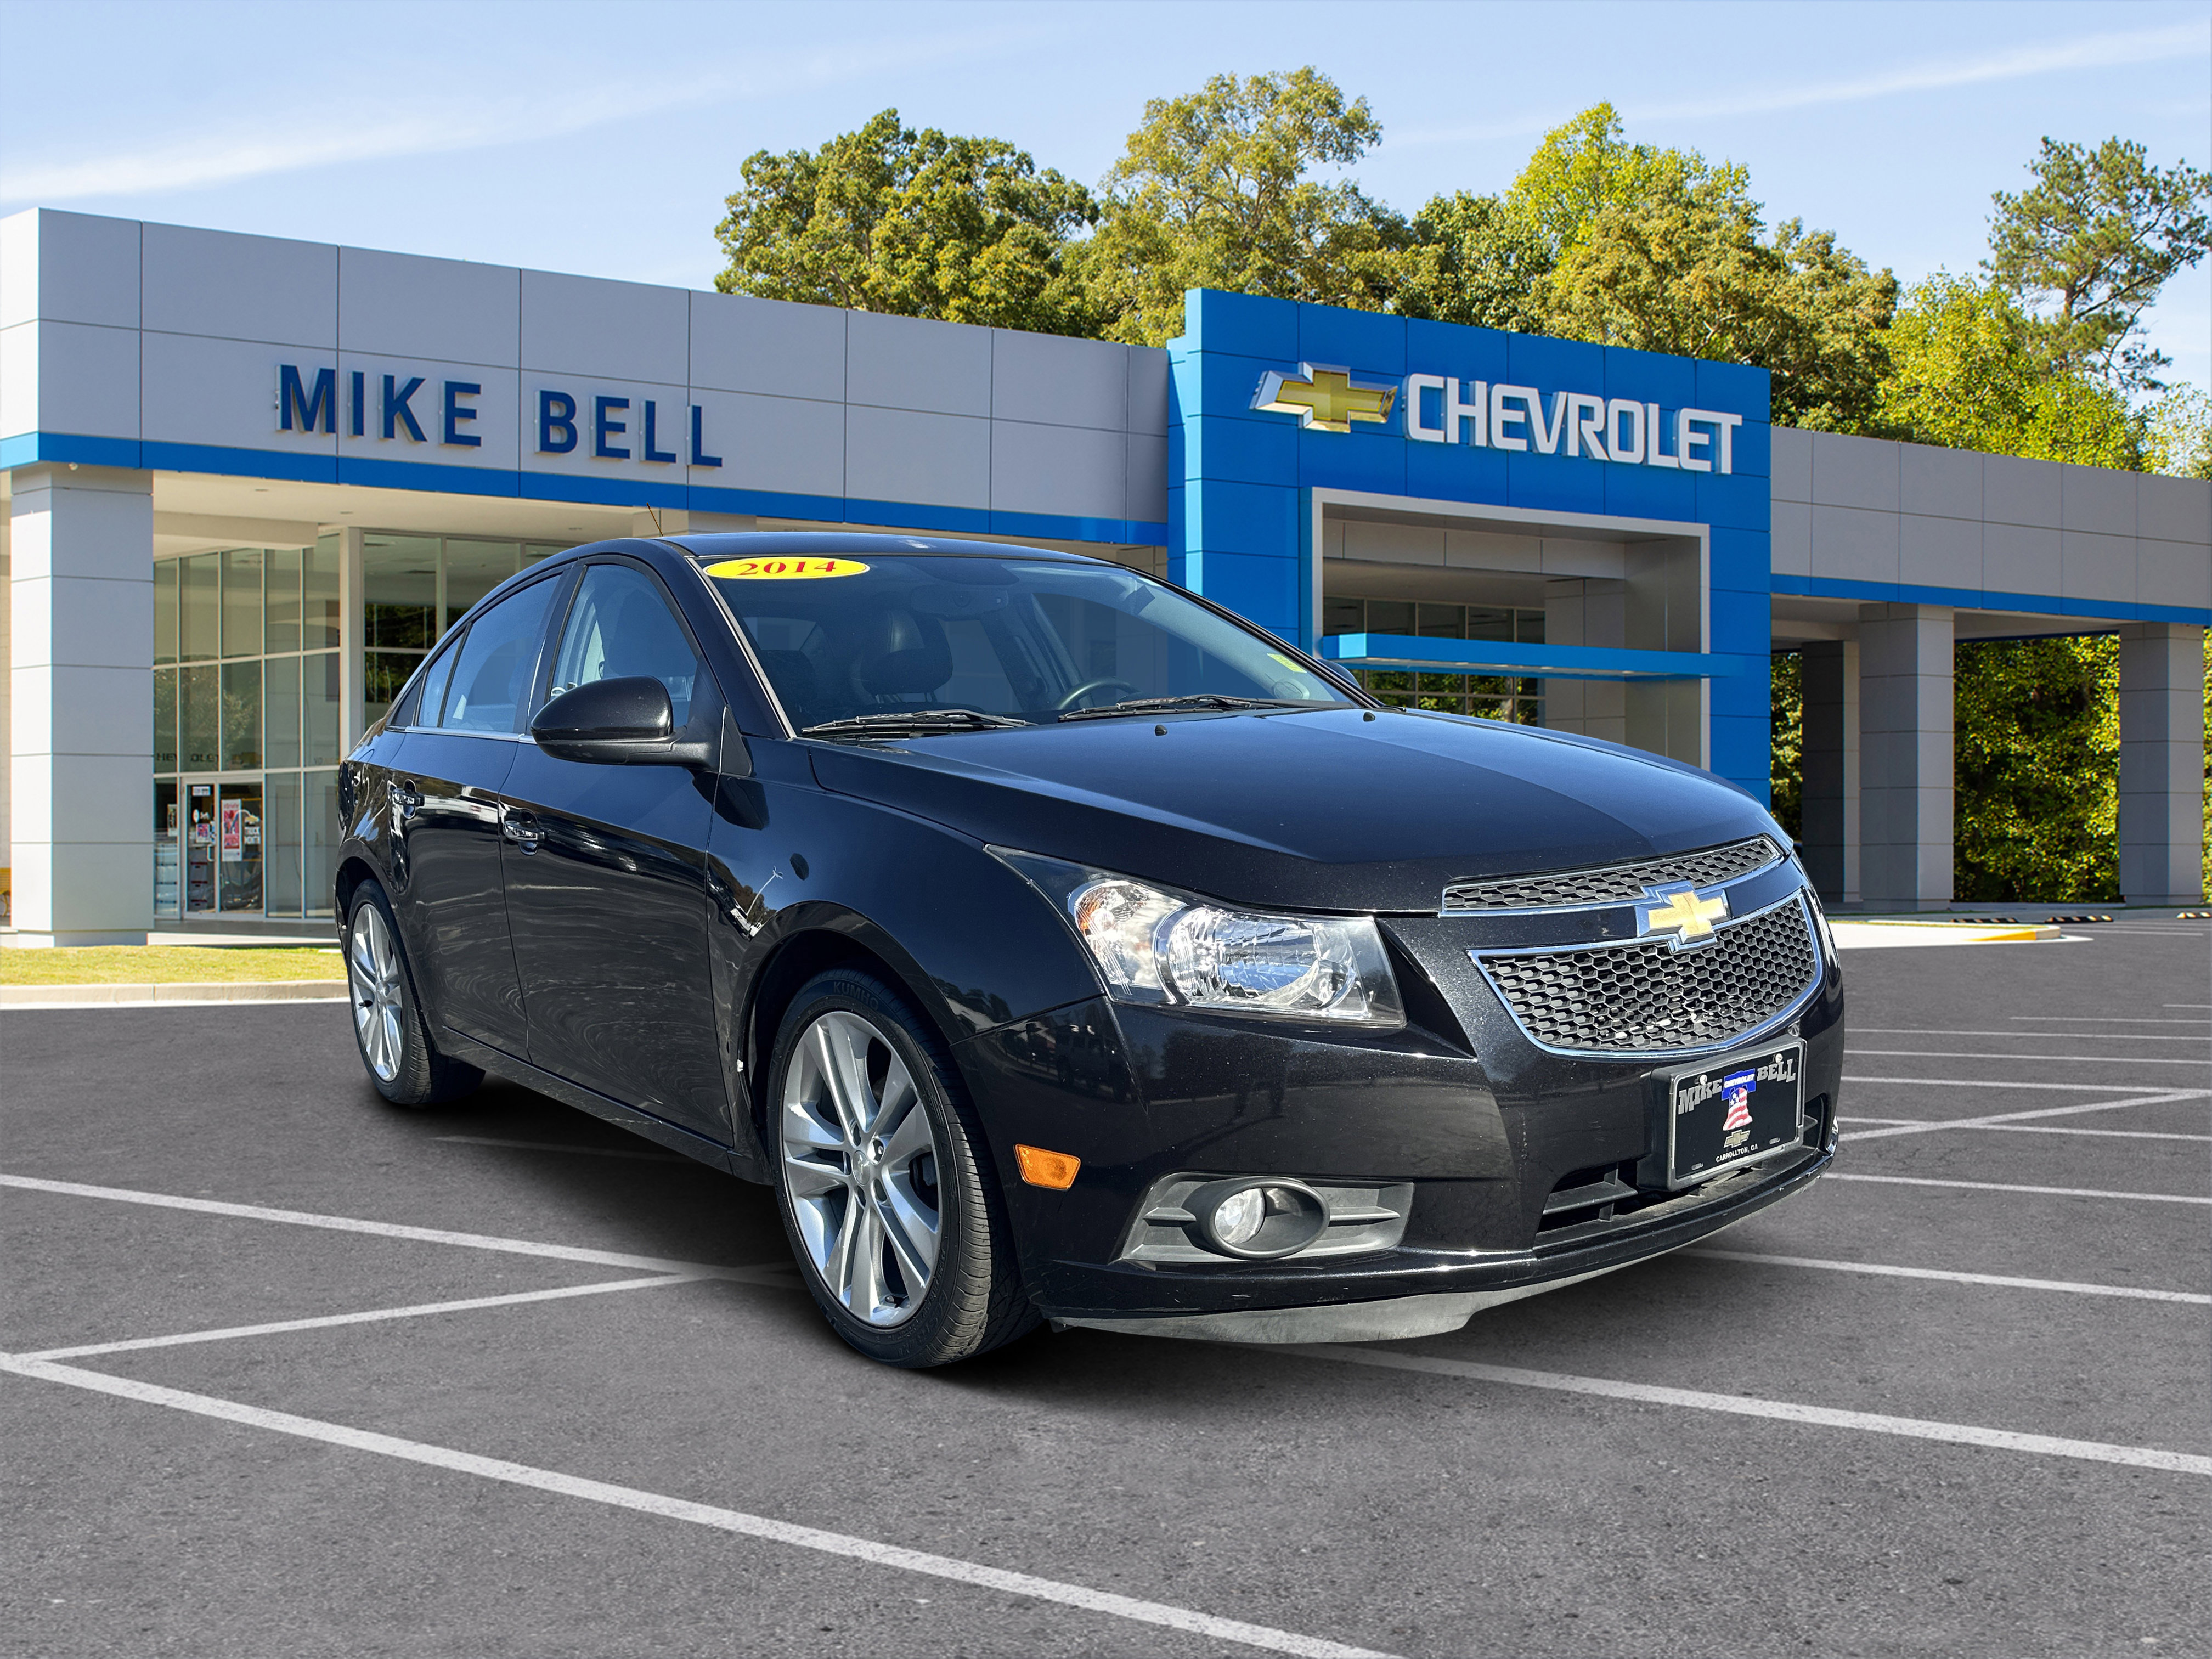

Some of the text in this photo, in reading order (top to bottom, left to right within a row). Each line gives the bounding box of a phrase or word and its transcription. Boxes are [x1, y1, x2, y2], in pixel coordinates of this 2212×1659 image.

[276, 364, 723, 468] MIKE BELL
[1403, 373, 1743, 475] CHEVROLET
[736, 561, 837, 575] 2014
[833, 981, 879, 1011] KUMHO
[1678, 1059, 1796, 1115] MIKE BELL
[1723, 1073, 1755, 1089] CHEVROLET
[1716, 1146, 1750, 1163] CARROLLTON,
